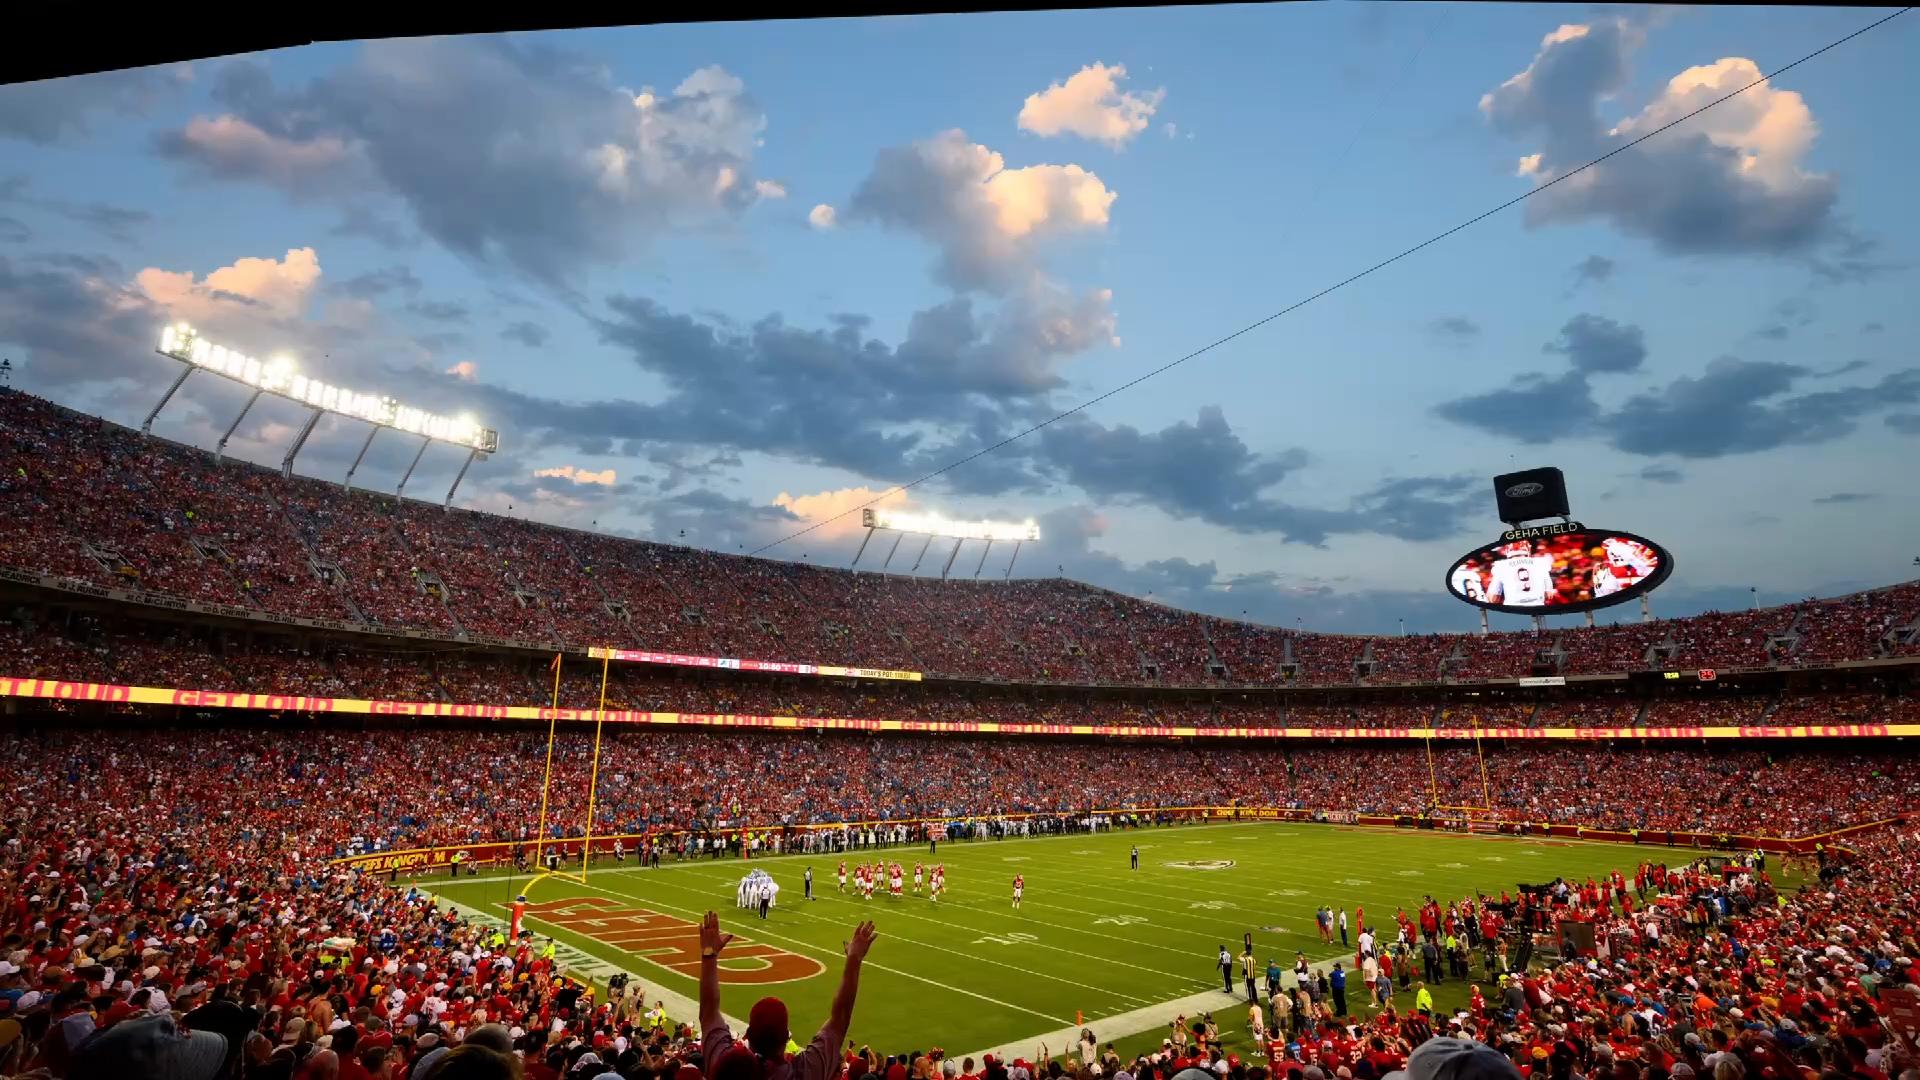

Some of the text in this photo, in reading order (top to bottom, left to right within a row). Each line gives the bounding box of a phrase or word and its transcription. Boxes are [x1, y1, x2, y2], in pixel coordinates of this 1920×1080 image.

[1505, 522, 1578, 540] GEHA FIELD
[220, 608, 251, 618] CHERRY
[172, 688, 334, 712] GET LOUD
[369, 700, 508, 718] GET LOUD
[539, 708, 651, 723] GET LOUD
[677, 713, 773, 726] GET LOUD
[796, 717, 832, 728] GET
[1484, 728, 1545, 738] LOUD
[1574, 727, 1704, 738] GET LOUD
[1738, 725, 1889, 738] GET LOUD
[384, 851, 446, 868] KNGDM
[1273, 1052, 1284, 1062] 52
